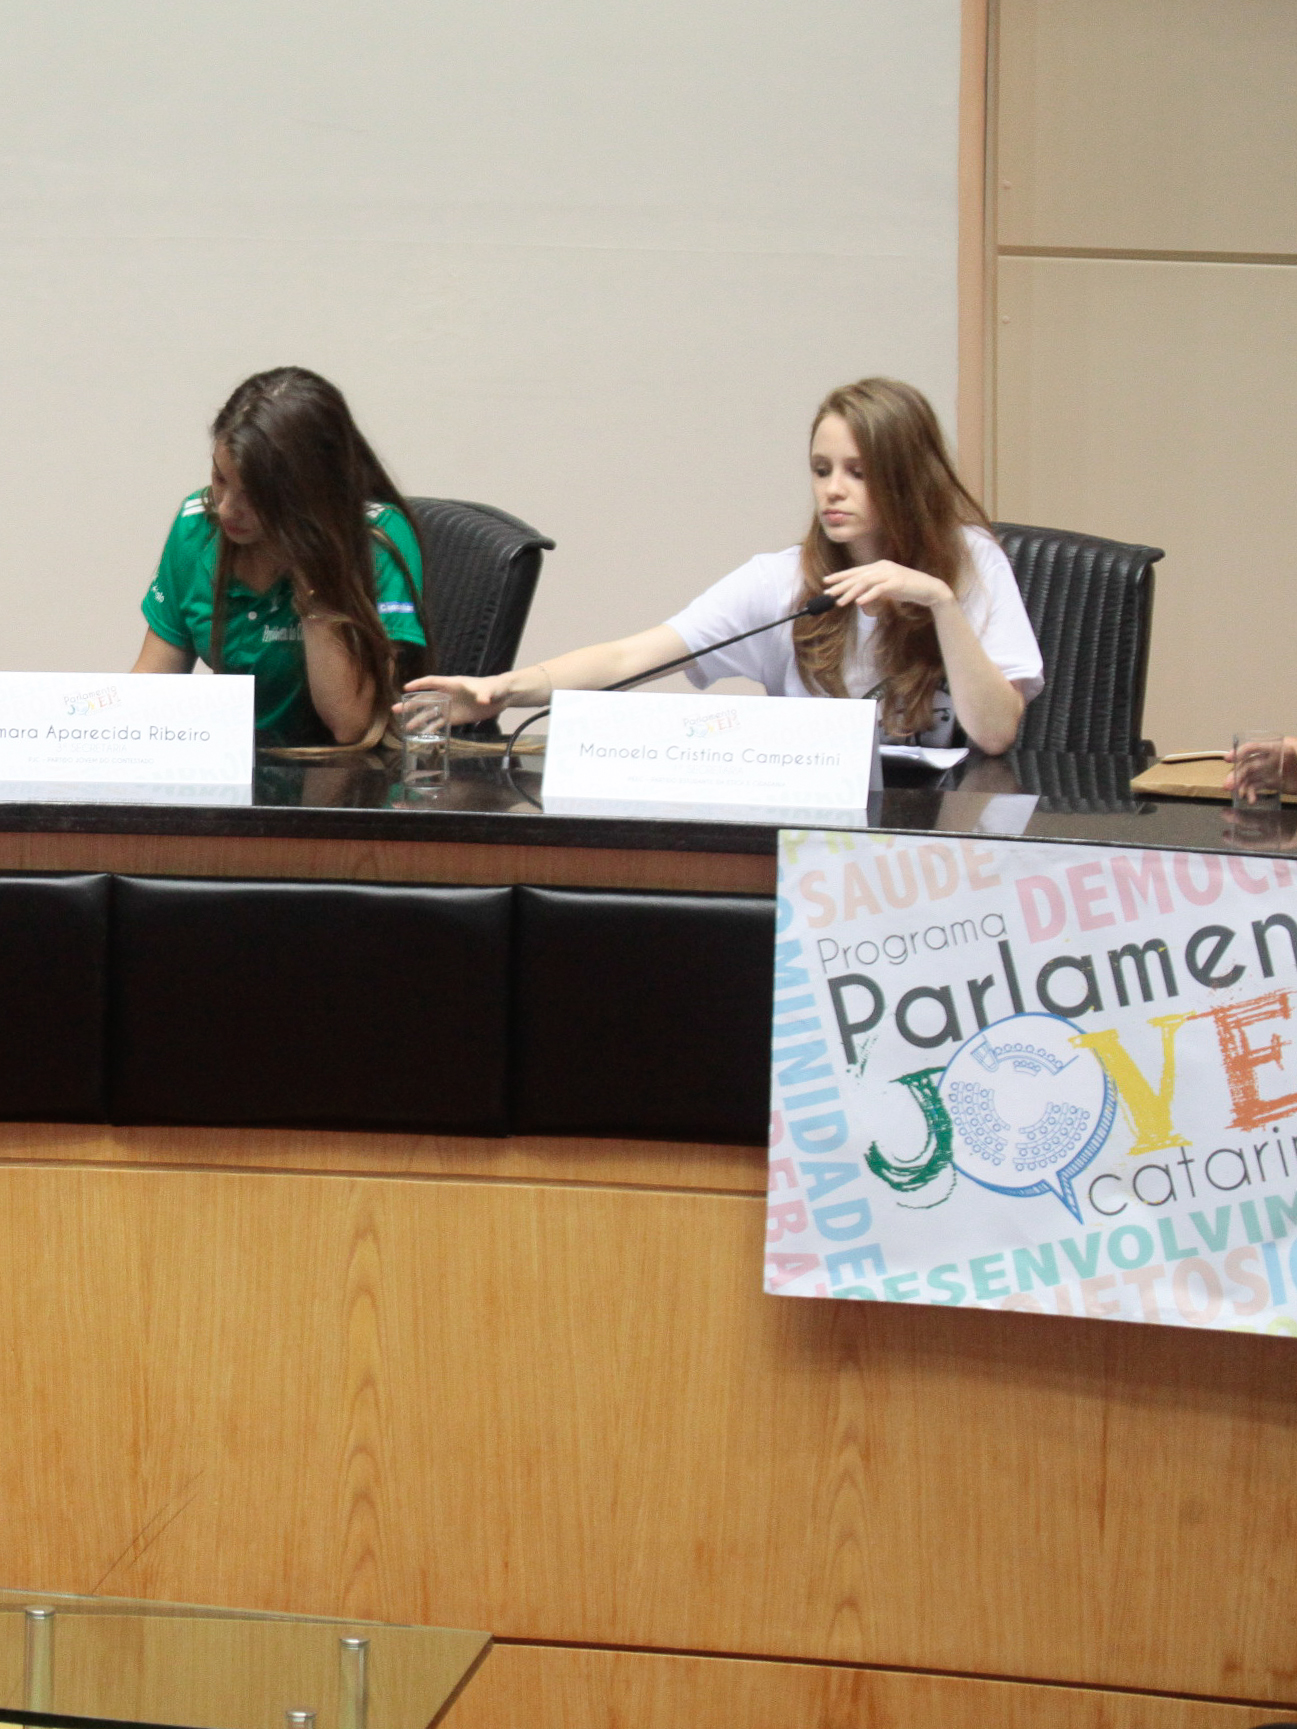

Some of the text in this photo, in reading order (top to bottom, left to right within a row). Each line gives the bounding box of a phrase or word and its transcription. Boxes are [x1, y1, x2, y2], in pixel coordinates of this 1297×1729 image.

[46, 724, 142, 742] Aparecida
[149, 726, 212, 742] Ribeiro
[579, 743, 841, 767] Manoela Cristina Campestini
[799, 838, 1003, 930] SAÚDE
[817, 913, 1008, 975] Programa
